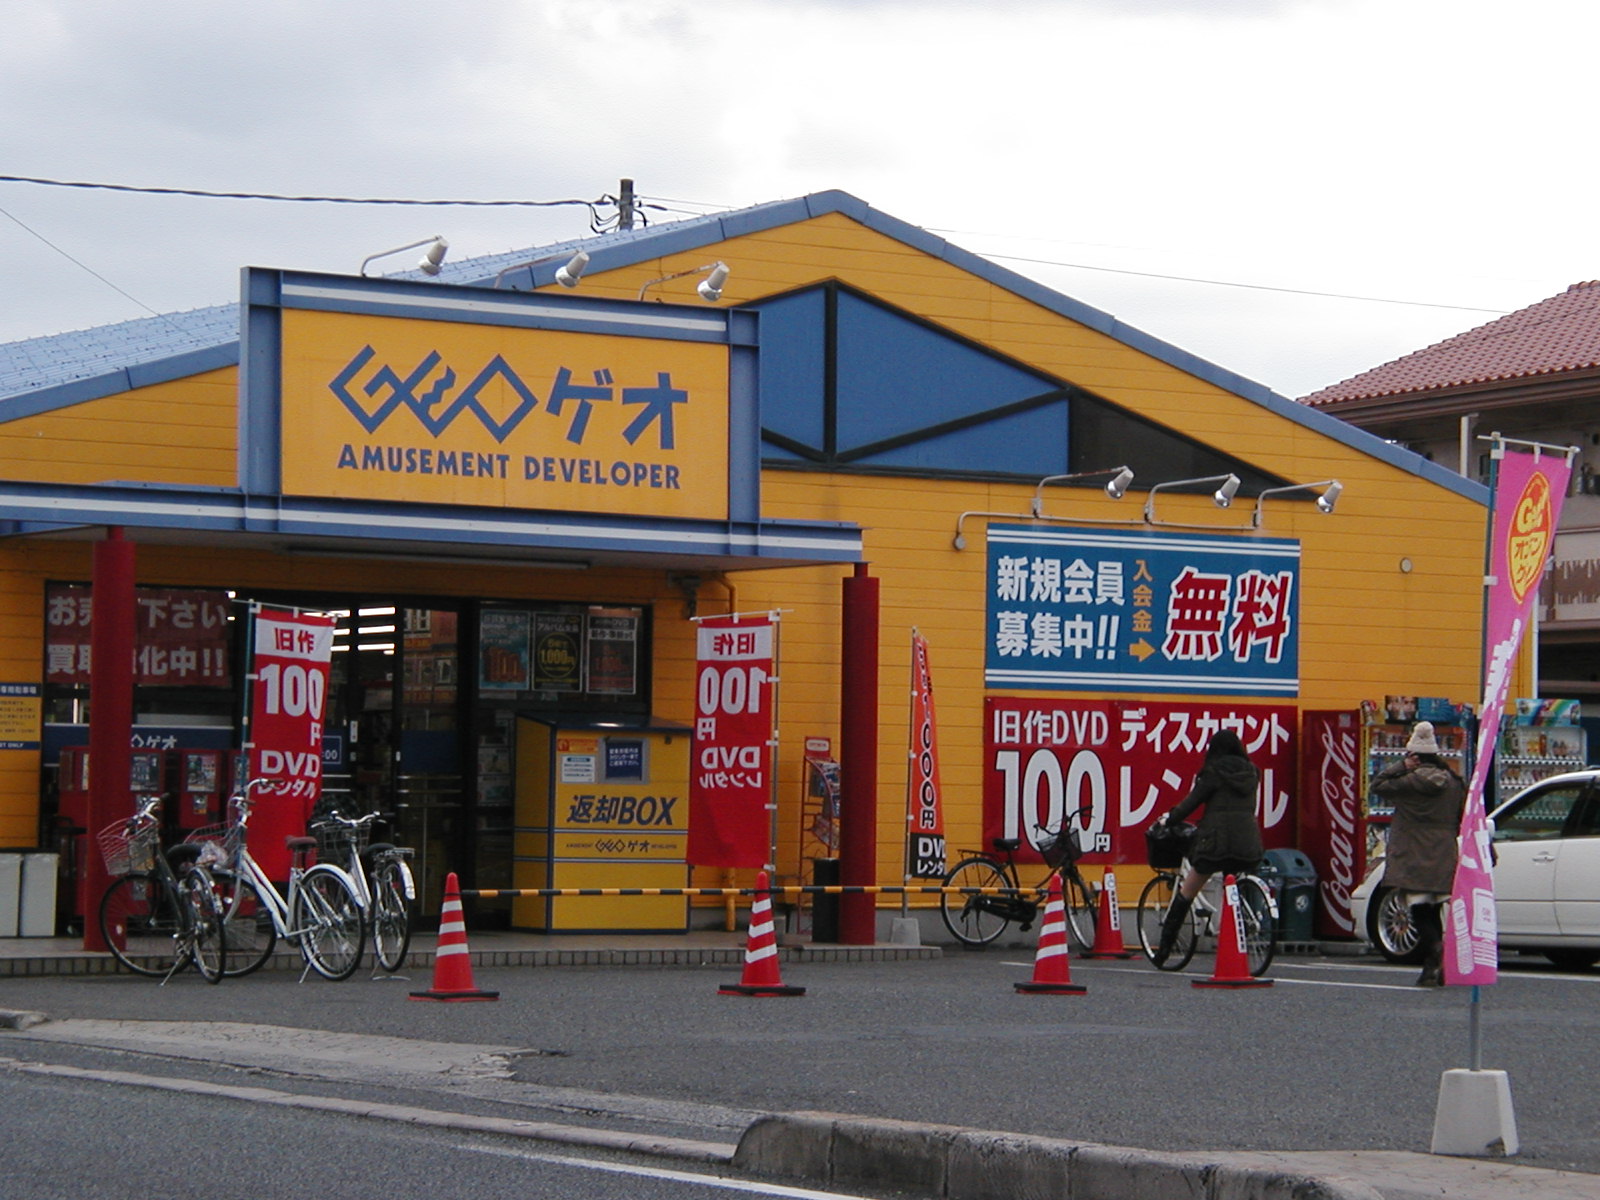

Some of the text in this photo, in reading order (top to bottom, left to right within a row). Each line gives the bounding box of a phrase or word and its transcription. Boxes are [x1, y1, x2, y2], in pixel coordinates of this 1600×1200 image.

[546, 366, 689, 450] ゲオ
[337, 444, 682, 490] AMUSEMENT DEVELOPER
[997, 555, 1125, 606] 新規会員
[1132, 559, 1153, 632] 入会金
[48, 596, 227, 629] お下さい
[996, 611, 1121, 661] 募集中!!
[1161, 566, 1294, 662] 無料
[274, 628, 315, 654] 旧作
[260, 663, 324, 720] 100
[993, 709, 1109, 745] 旧作DVD
[260, 750, 320, 778] DVD
[566, 795, 678, 826] 返却BOX
